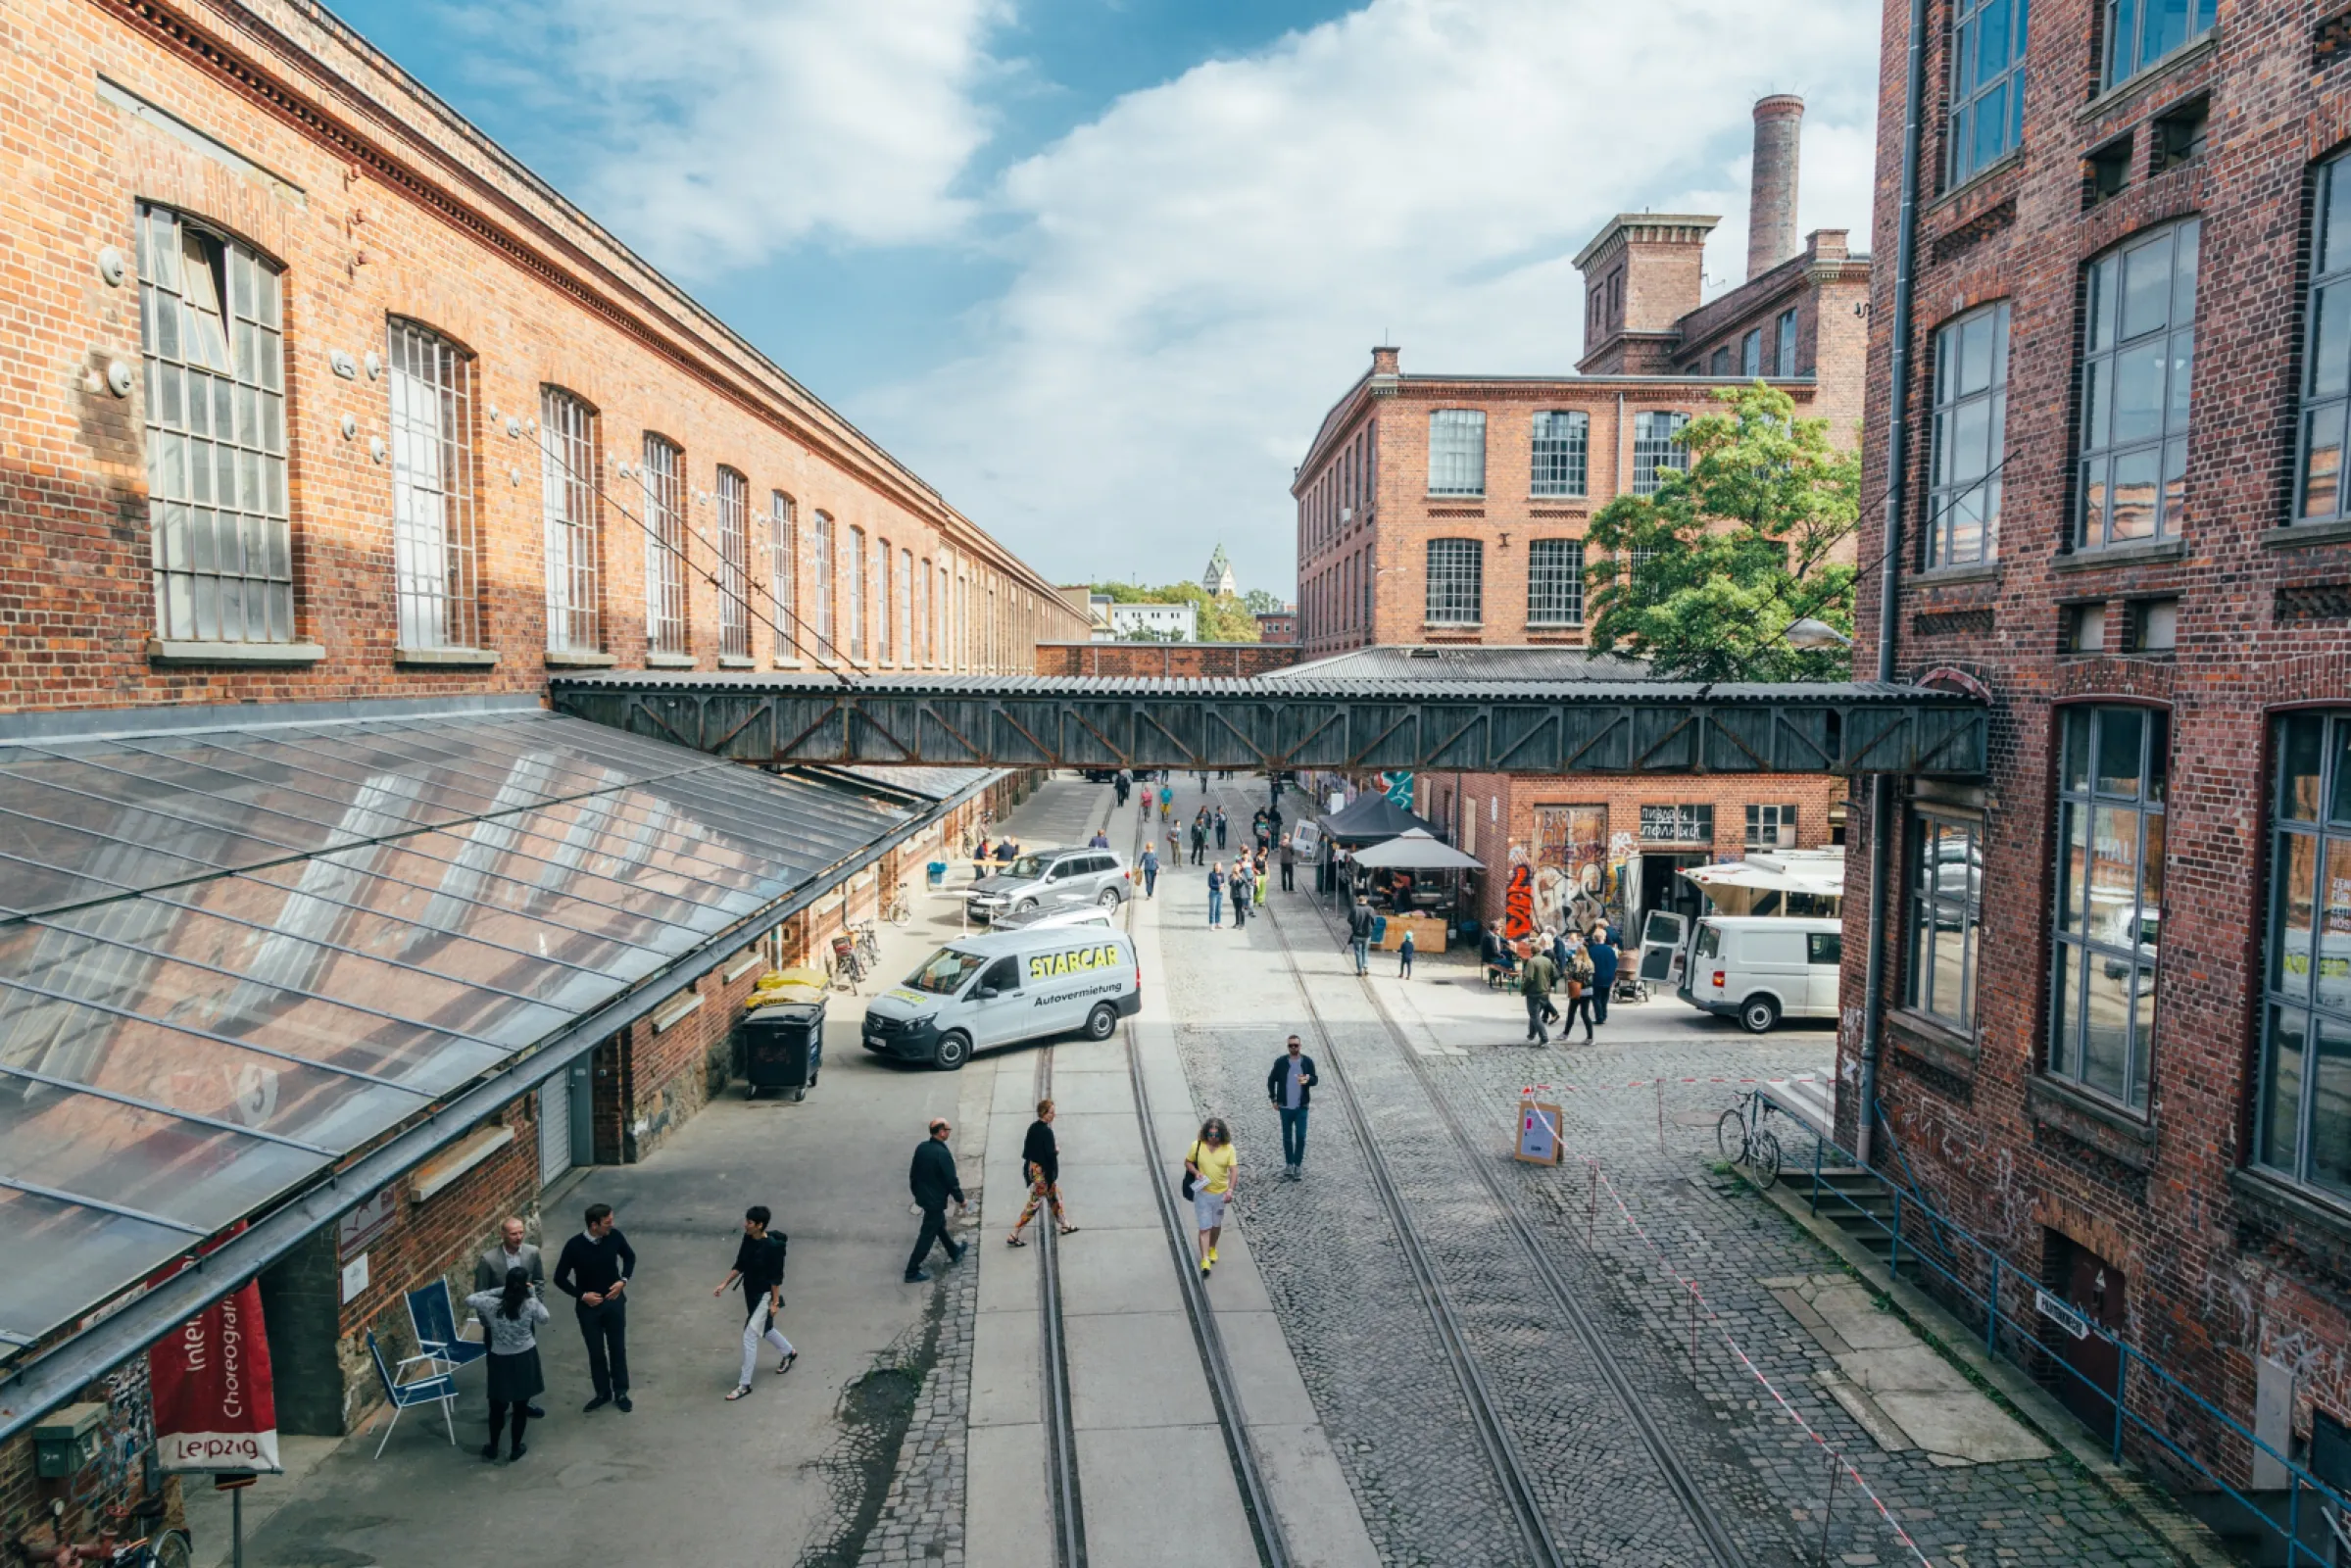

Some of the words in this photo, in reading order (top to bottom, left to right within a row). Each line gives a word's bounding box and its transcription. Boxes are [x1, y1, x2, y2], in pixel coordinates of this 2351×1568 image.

[1030, 945, 1118, 979] STARCAR
[1034, 983, 1122, 1007] Autovermietung
[177, 1439, 259, 1460] Leipzig
